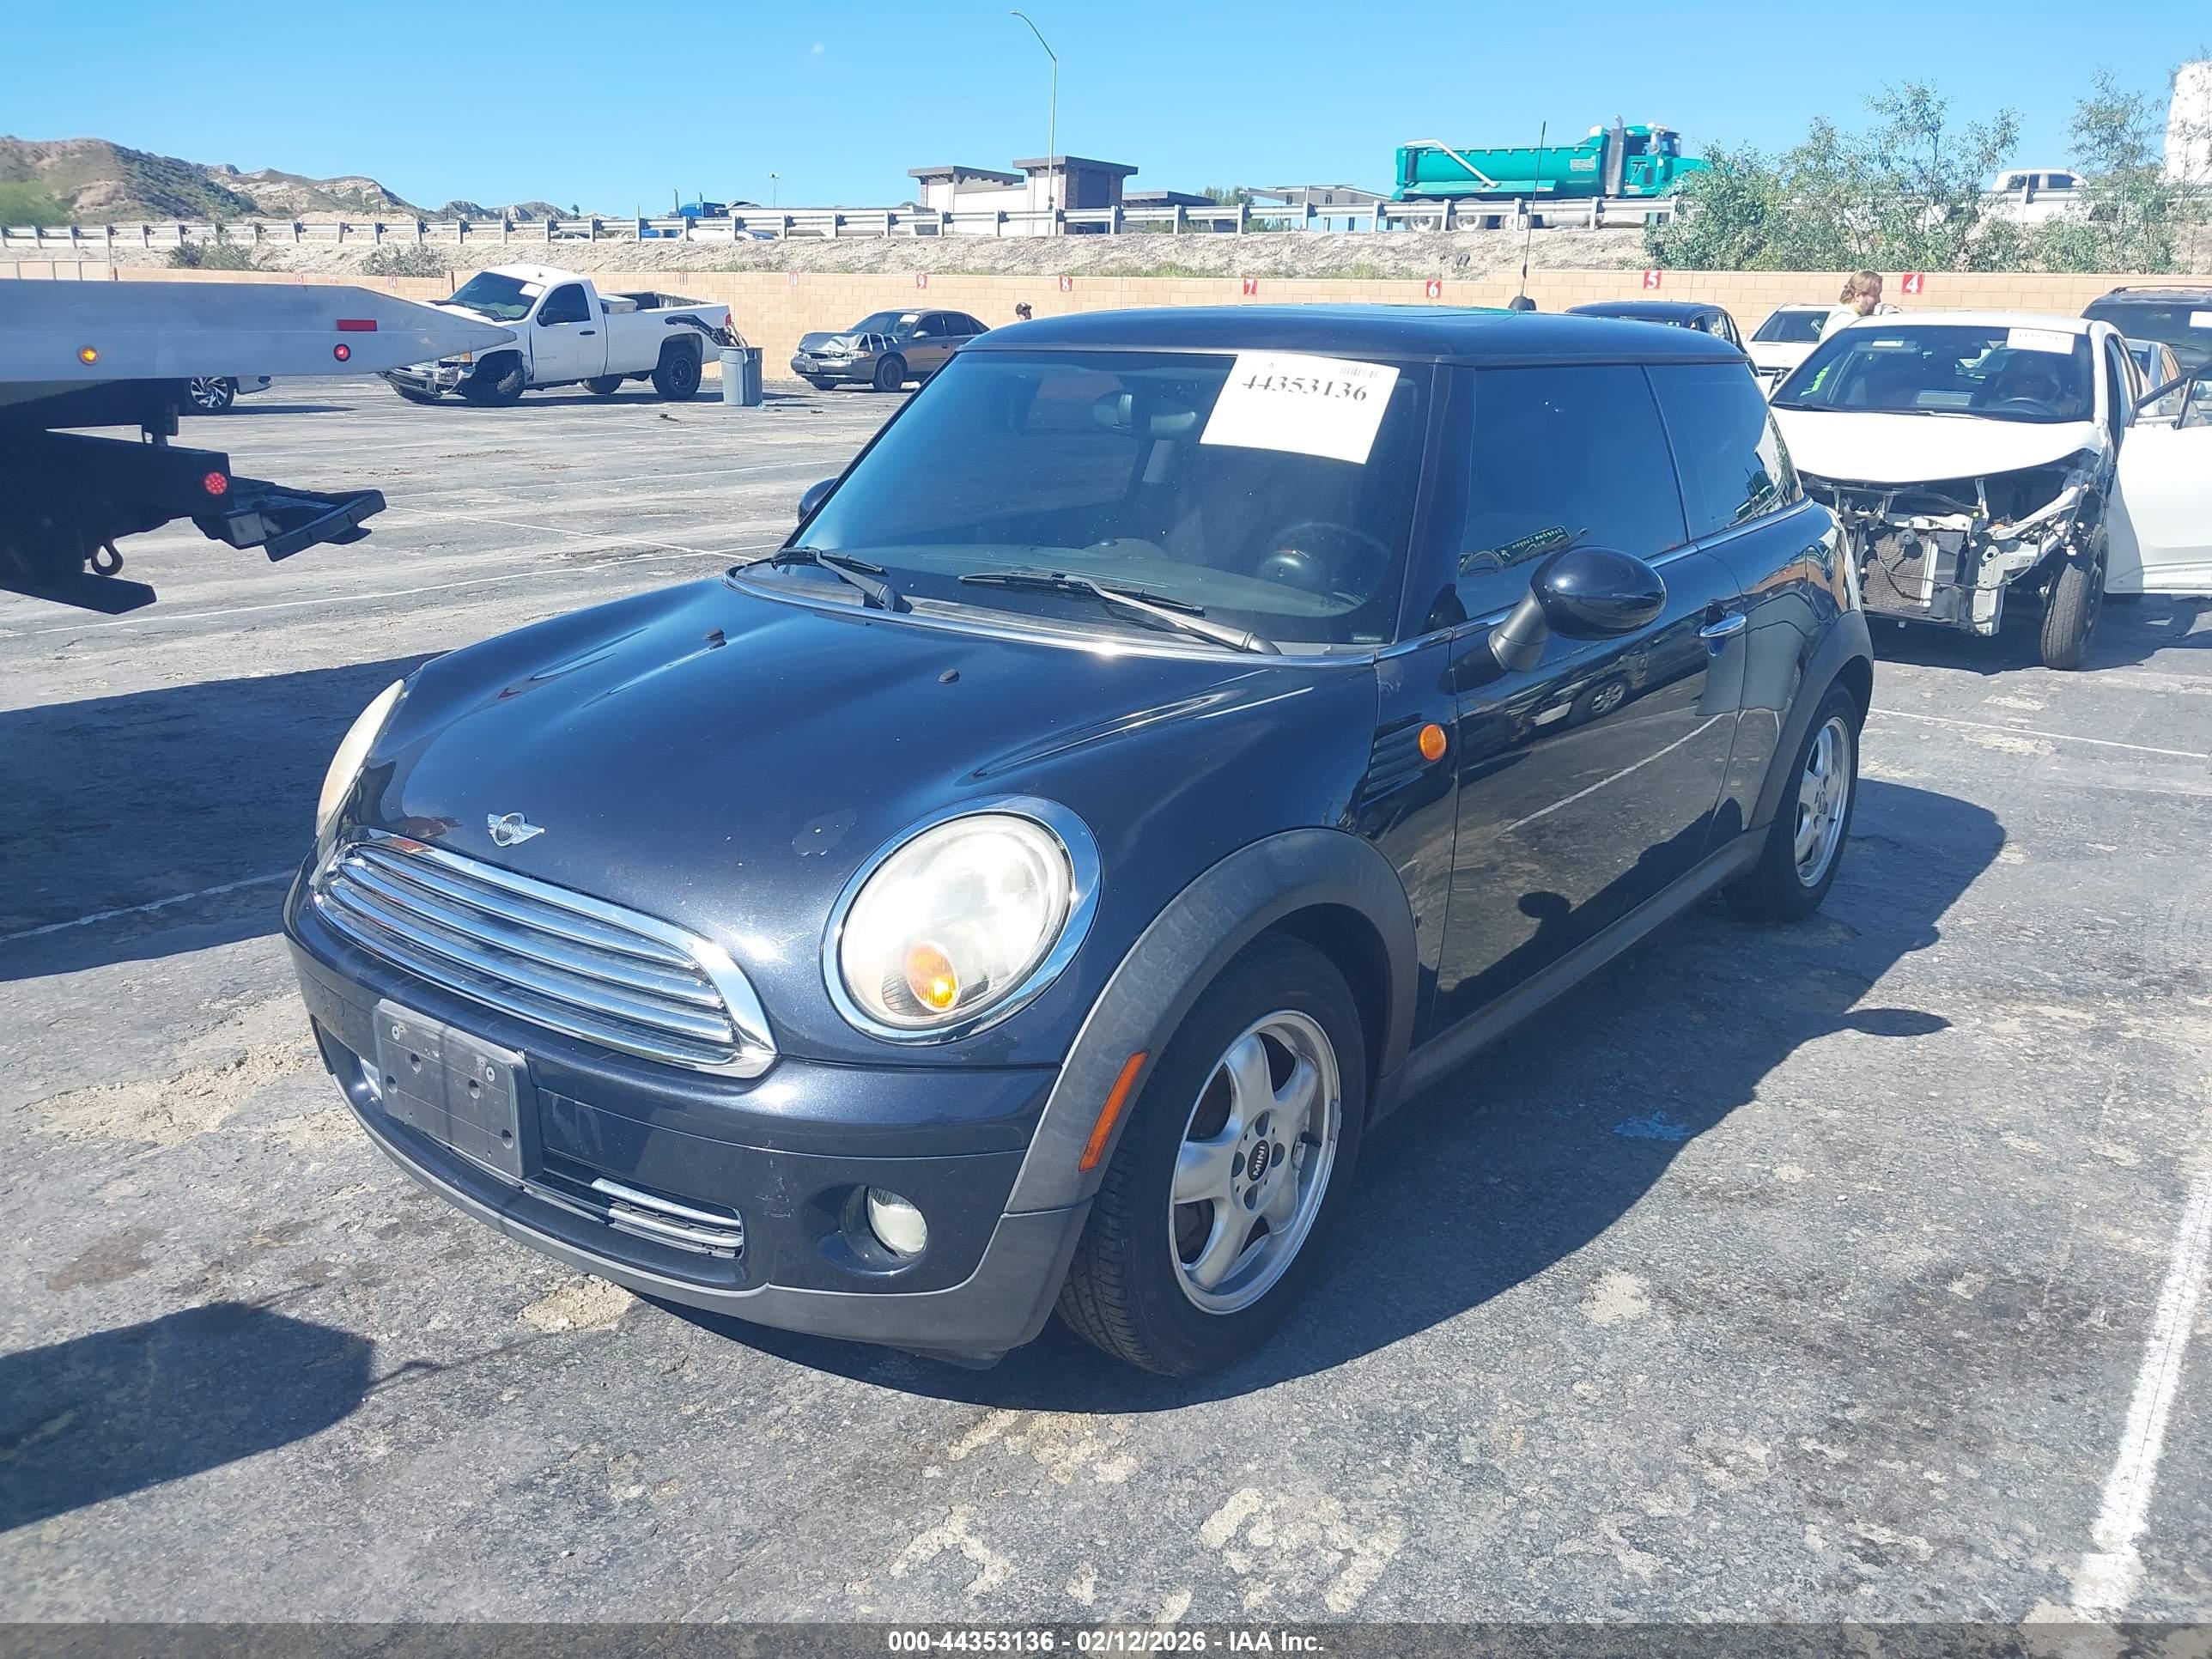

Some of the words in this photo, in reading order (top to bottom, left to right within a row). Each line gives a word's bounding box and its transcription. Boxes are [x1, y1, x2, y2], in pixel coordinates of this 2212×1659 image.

[1061, 276, 1070, 291] 8
[1245, 278, 1255, 295] 7
[1429, 280, 1439, 297] 6
[1646, 270, 1658, 289] 5
[1905, 272, 1919, 294] 4
[1242, 374, 1367, 401] 44353136
[1252, 1145, 1266, 1176] MINI
